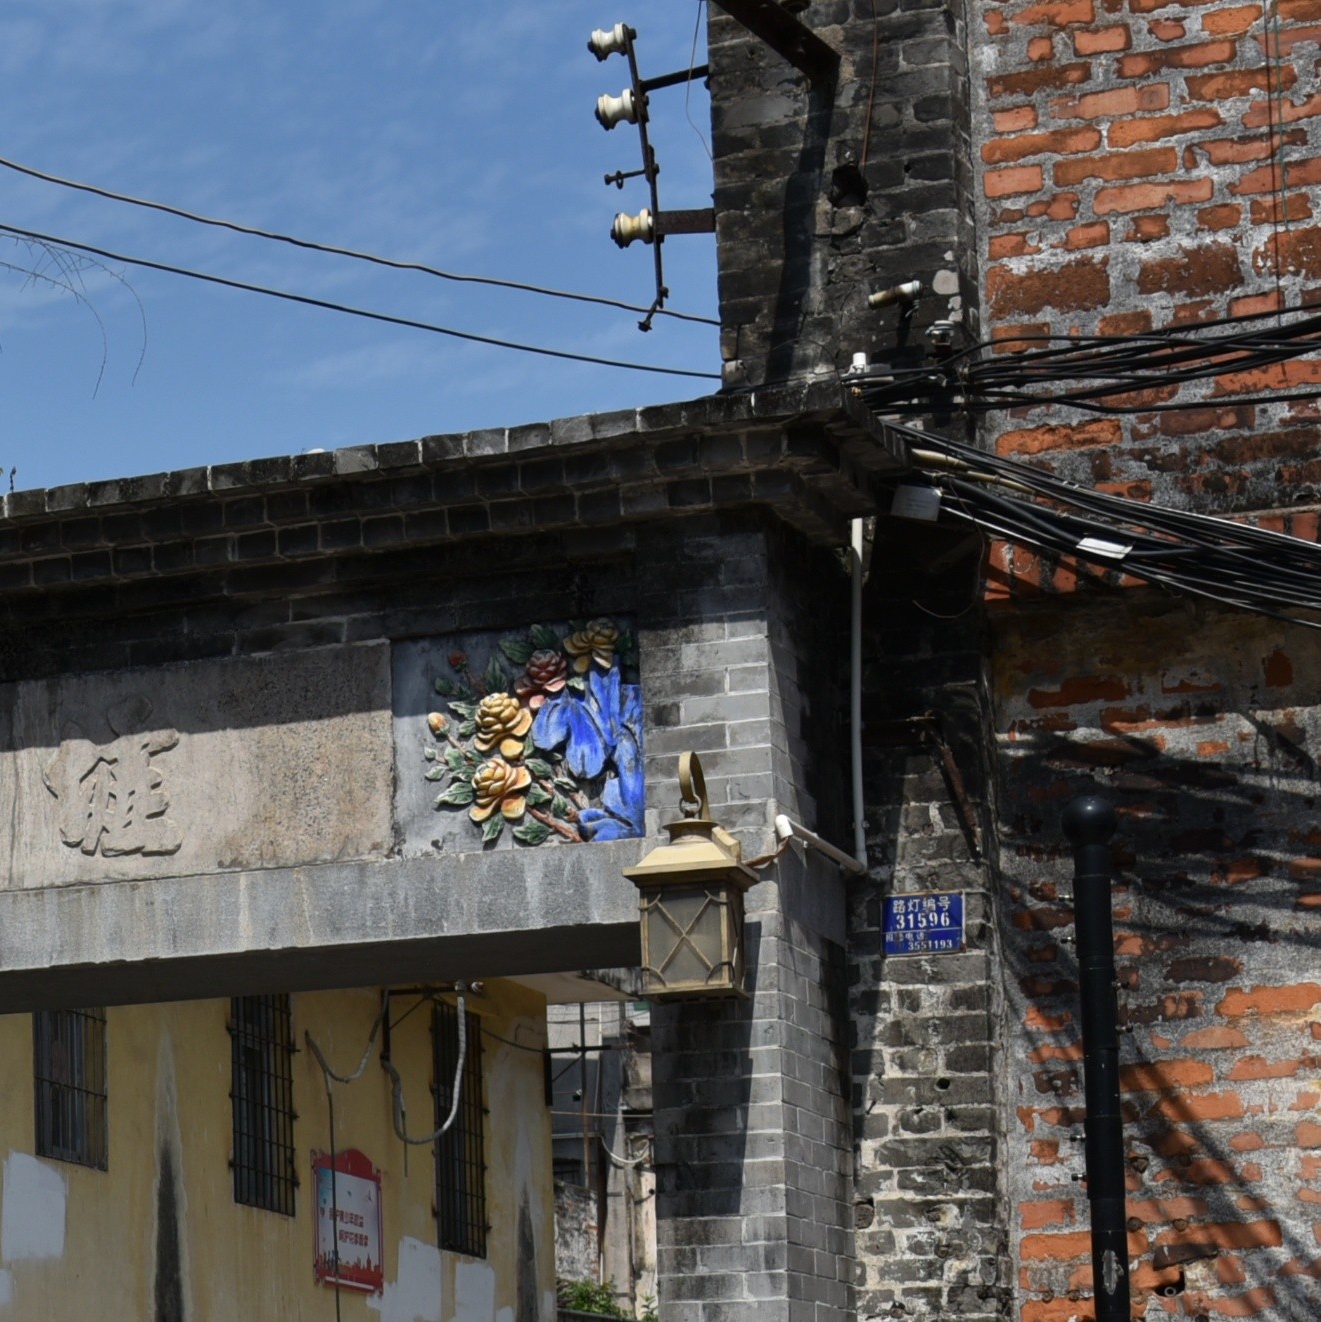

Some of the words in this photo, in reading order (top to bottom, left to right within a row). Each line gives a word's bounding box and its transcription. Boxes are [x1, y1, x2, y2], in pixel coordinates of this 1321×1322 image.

[892, 896, 951, 914] 路灯编号
[896, 912, 950, 930] 31596
[908, 939, 953, 951] 3551193
